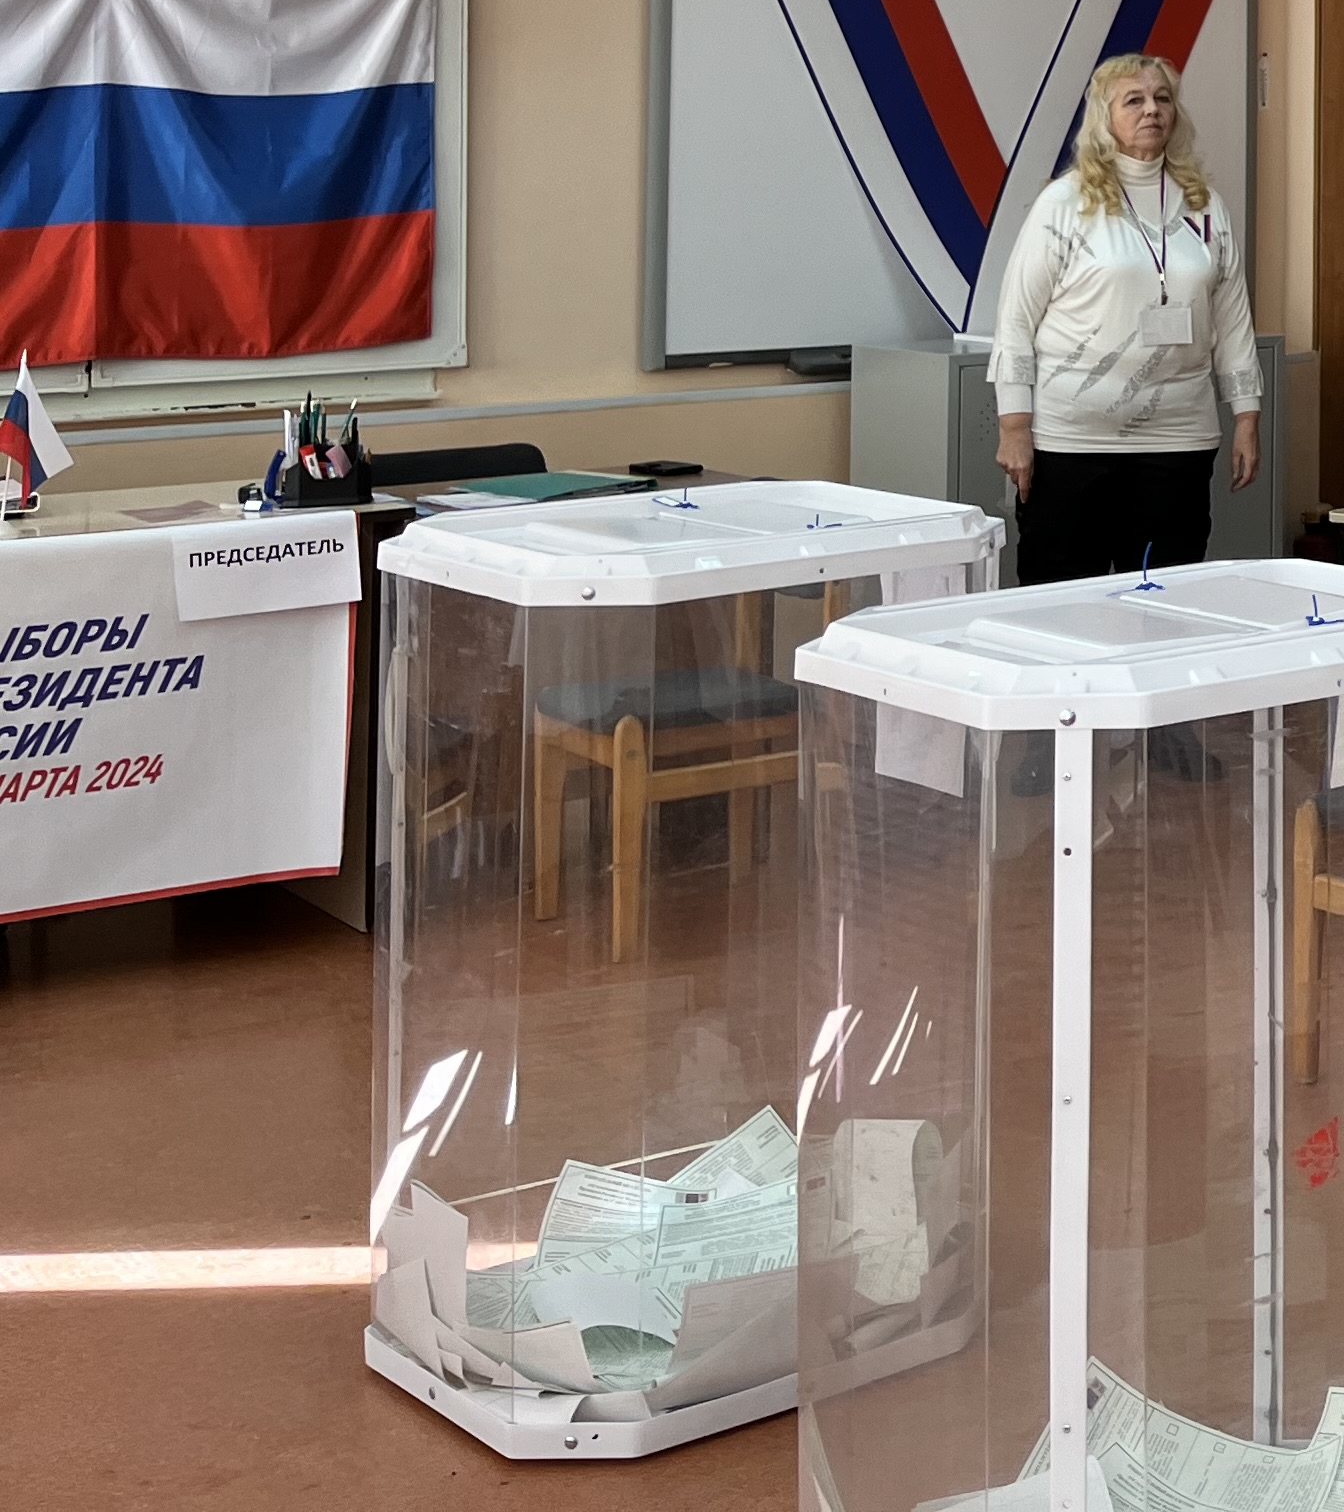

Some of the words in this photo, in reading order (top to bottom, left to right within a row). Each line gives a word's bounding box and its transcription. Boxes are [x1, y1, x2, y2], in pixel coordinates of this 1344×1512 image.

[189, 538, 344, 569] ПРЕДСЕДАТЕЛЬ
[0, 655, 205, 712] ЗИДЕНТА
[0, 764, 82, 805] АРТА
[85, 754, 164, 793] 2024
